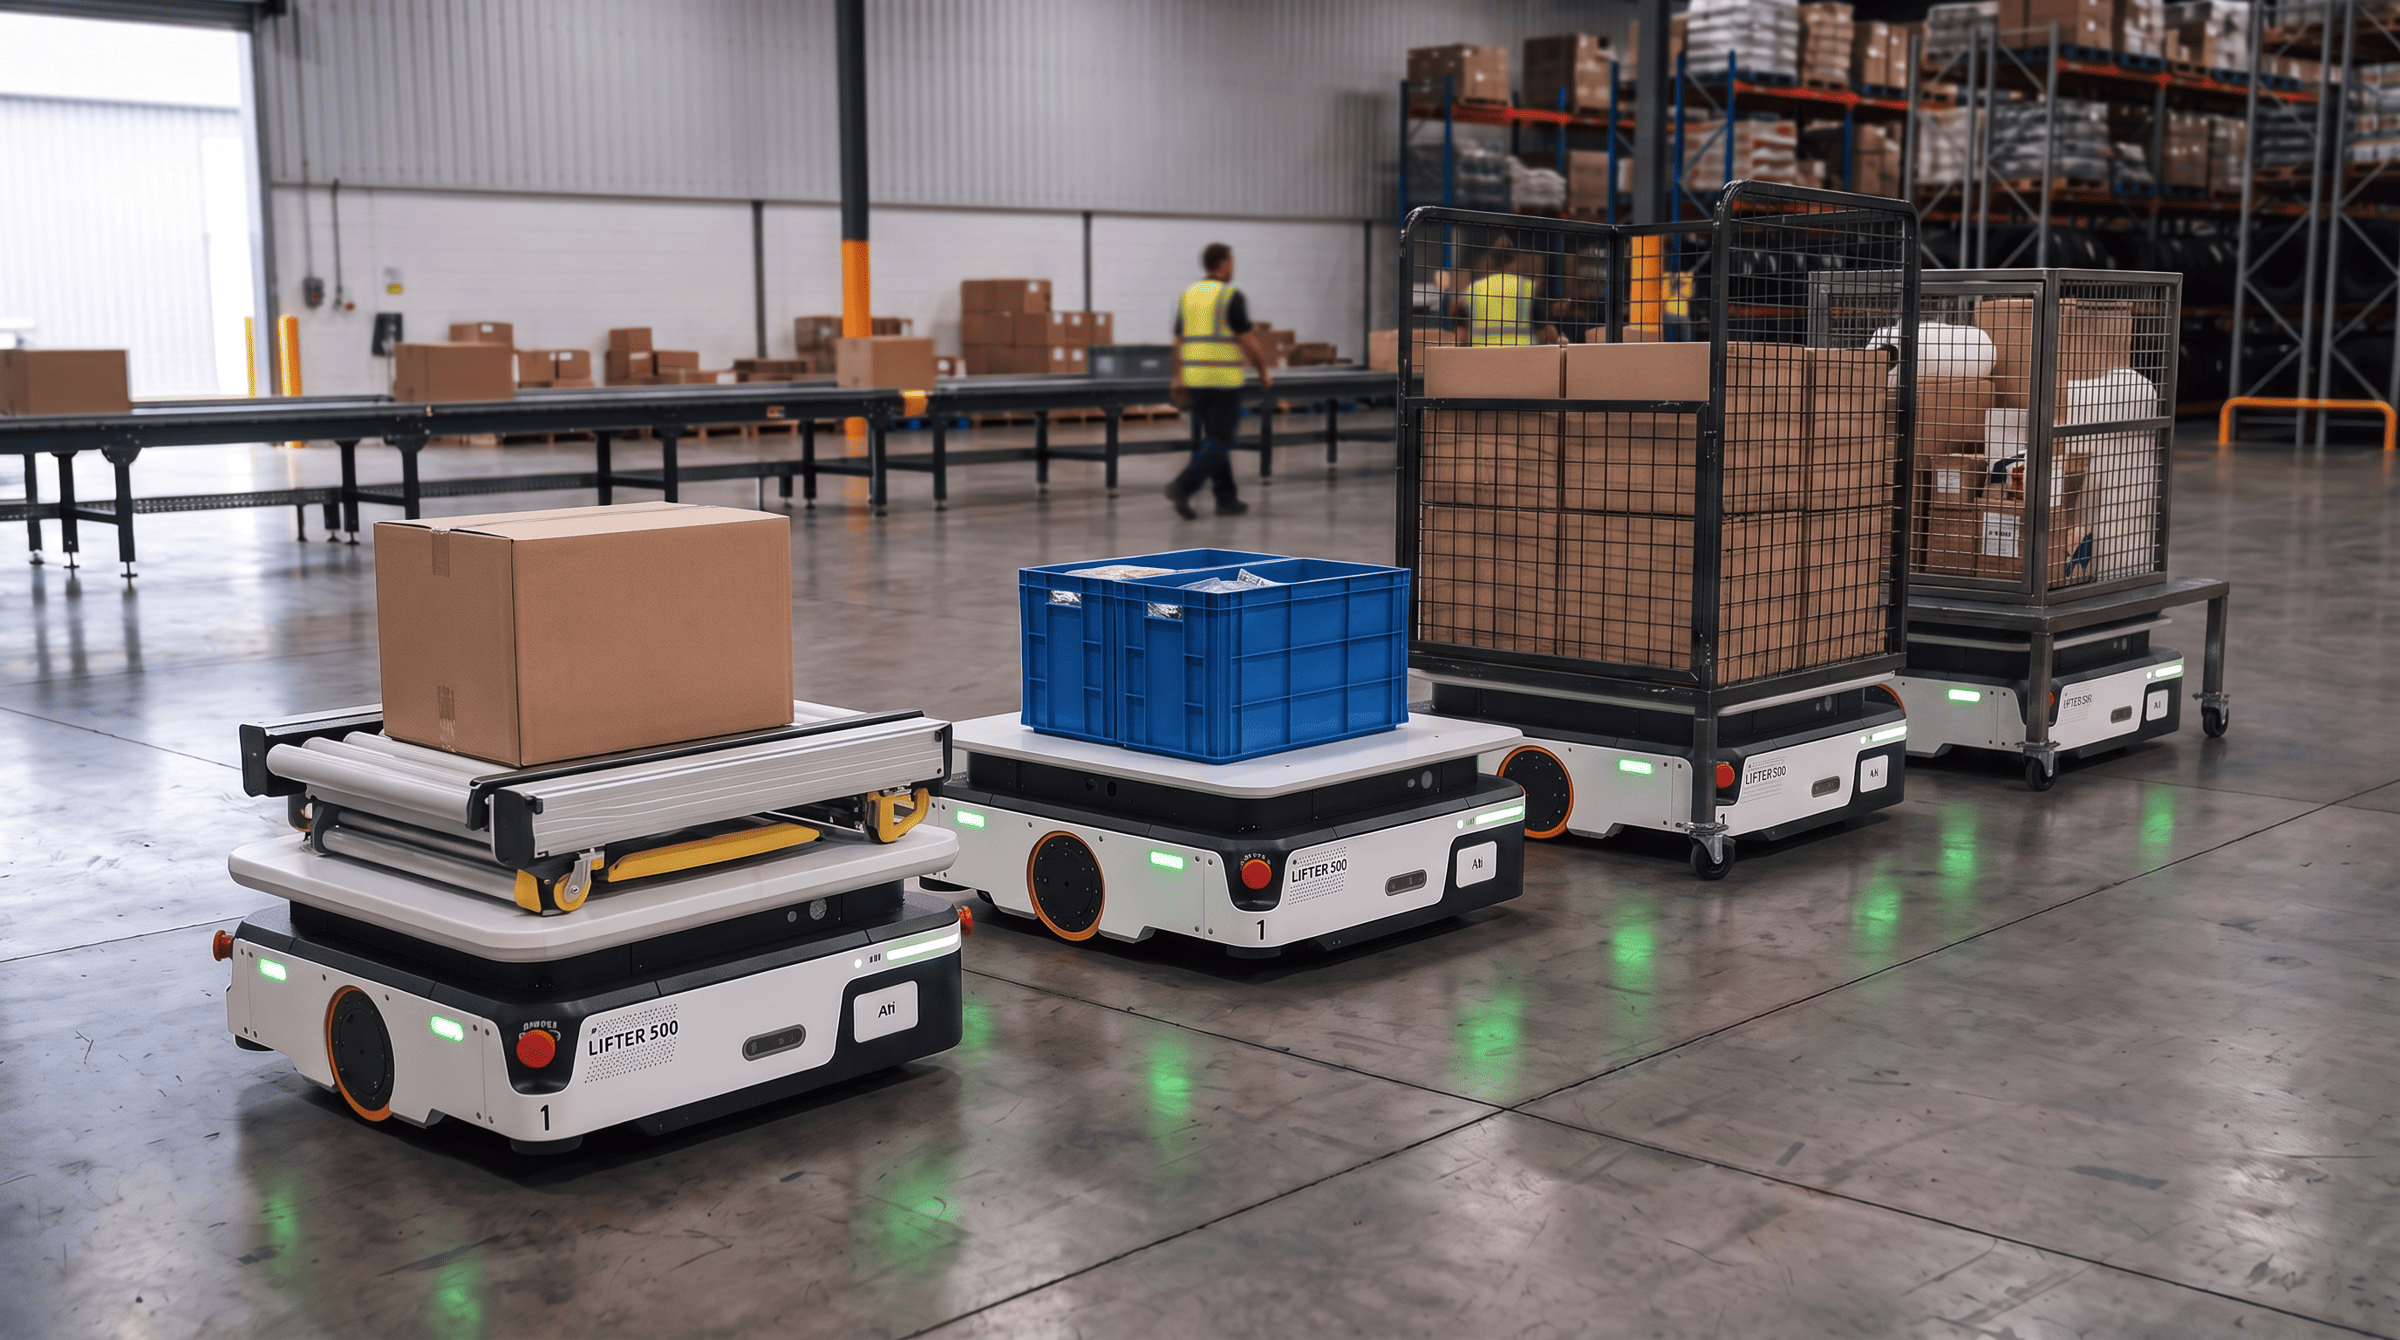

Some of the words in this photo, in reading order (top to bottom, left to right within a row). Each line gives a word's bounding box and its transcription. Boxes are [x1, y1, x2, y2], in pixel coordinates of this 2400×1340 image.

[1745, 768, 1773, 785] LIFTER
[1720, 813, 1725, 825] 1
[1292, 863, 1329, 883] LIFTER
[1330, 859, 1348, 874] 500
[1471, 856, 1484, 870] Ati
[1257, 920, 1265, 940] 1
[588, 1028, 646, 1056] LIFTER
[649, 1020, 679, 1041] 500
[540, 1104, 550, 1131] 1
